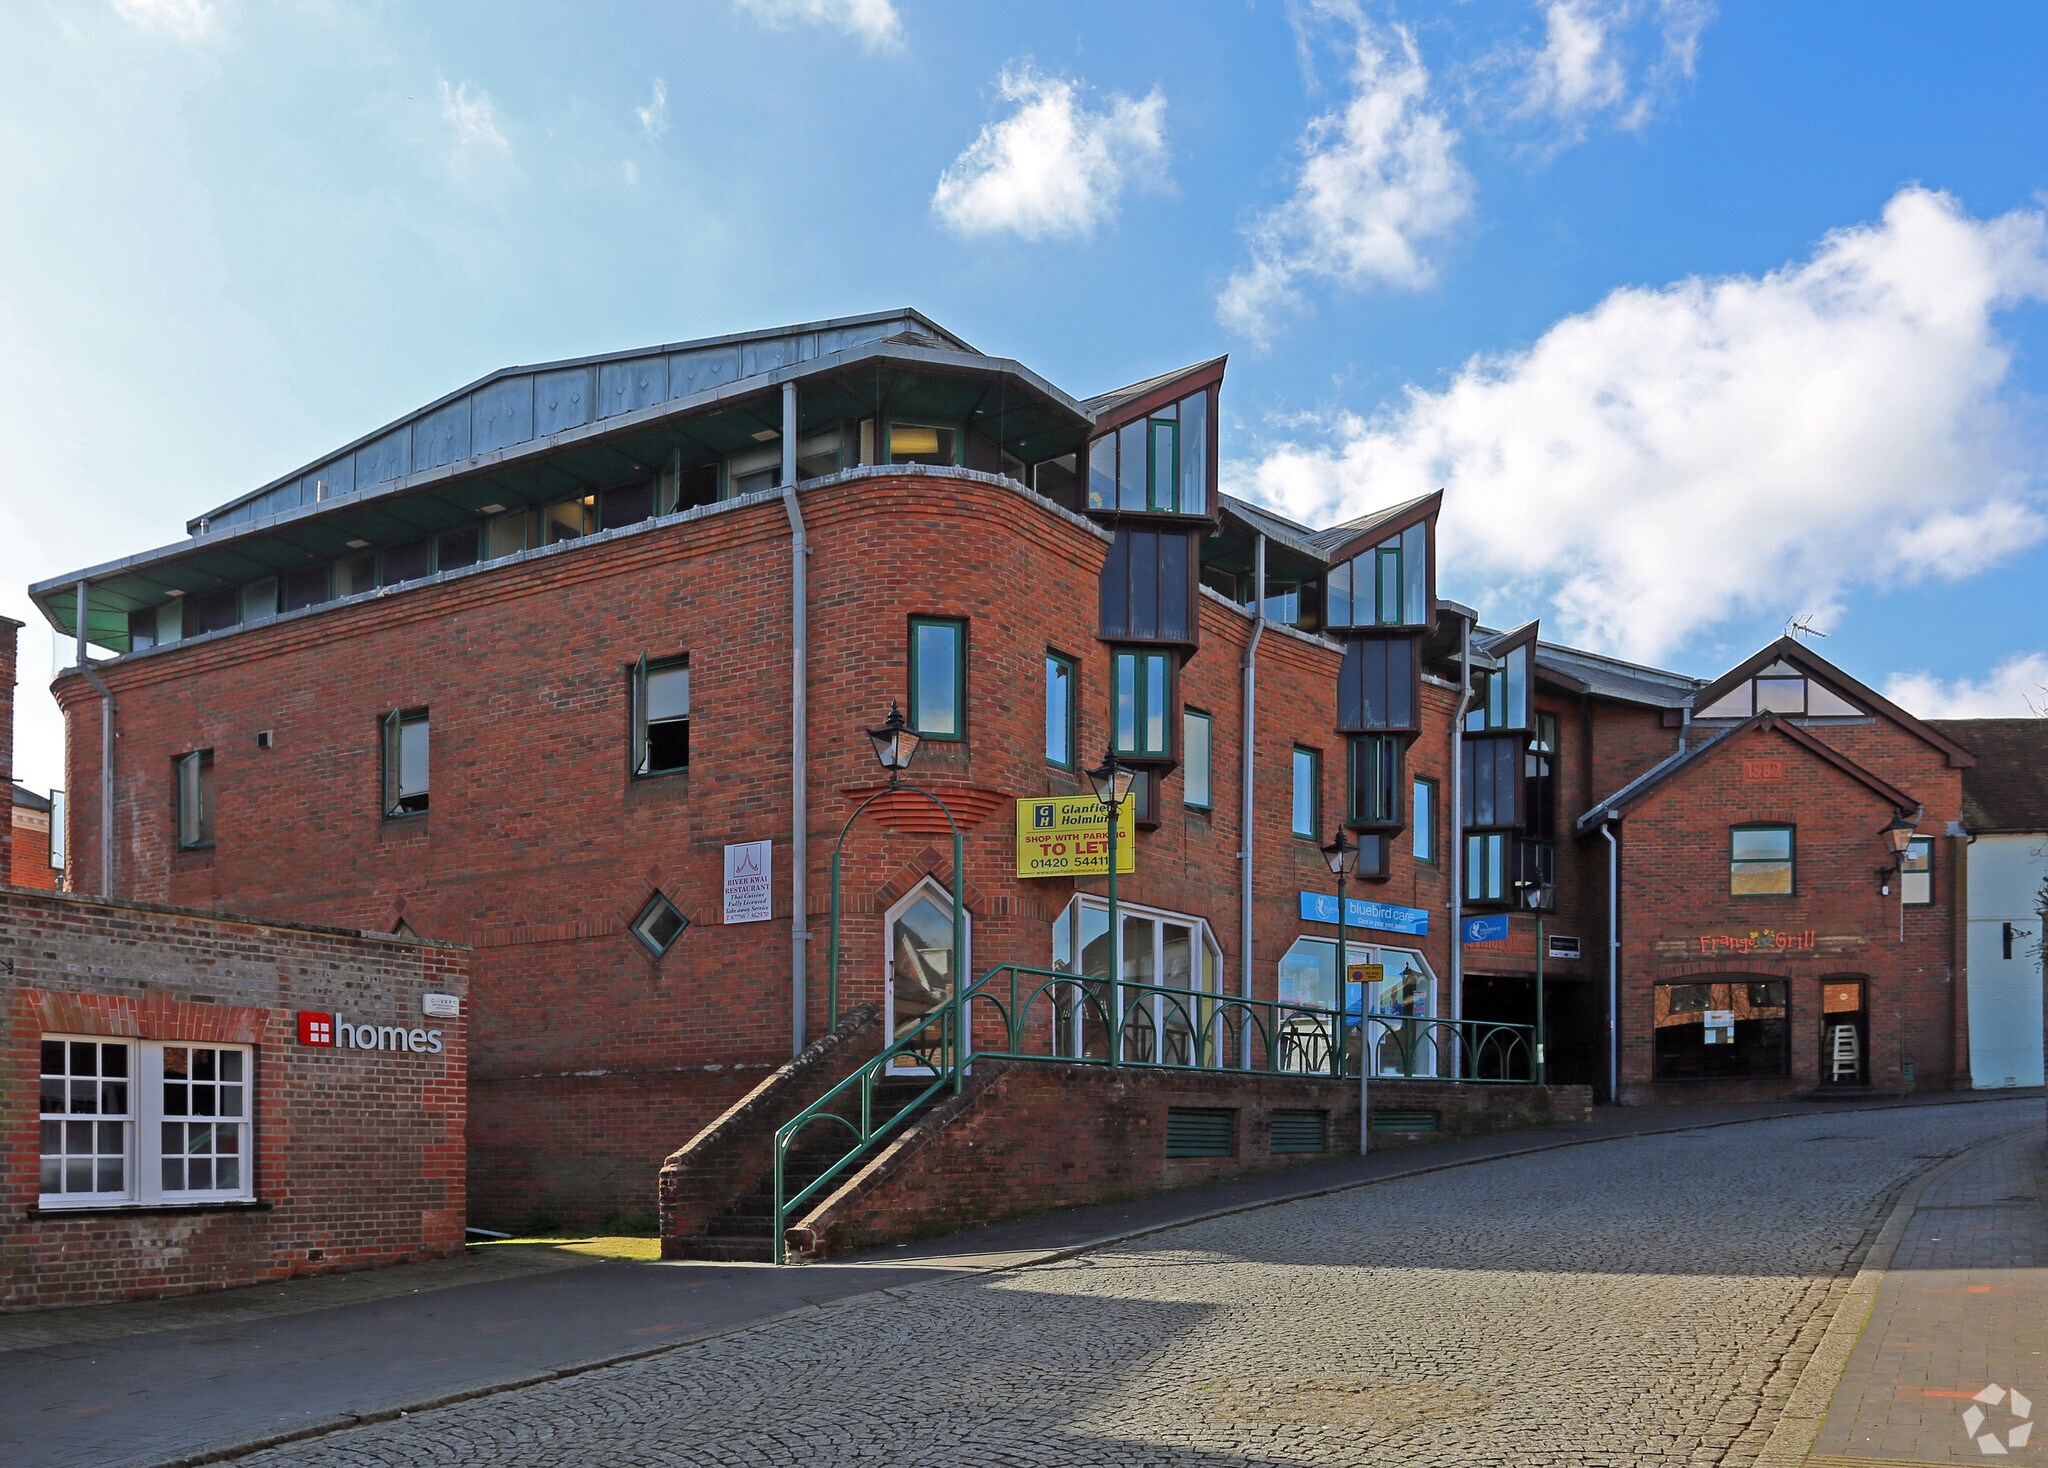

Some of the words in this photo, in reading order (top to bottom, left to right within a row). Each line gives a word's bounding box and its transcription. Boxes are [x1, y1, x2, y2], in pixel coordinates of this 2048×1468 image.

[1039, 806, 1049, 816] G
[1040, 817, 1049, 827] H
[1025, 835, 1051, 843] SHOP
[1055, 833, 1079, 841] WITH
[1083, 831, 1126, 840] PARKG
[1040, 843, 1066, 856] TO
[1075, 841, 1109, 855] LET
[1031, 857, 1069, 869] 01420
[1074, 856, 1109, 867] 54411
[728, 878, 748, 886] RIVER
[750, 876, 767, 884] KWAI
[725, 883, 770, 894] RESTAURANT
[1349, 901, 1392, 919] bluebird
[1393, 910, 1415, 922] care
[1698, 934, 1756, 954] Frango
[1774, 930, 1816, 950] Grill
[335, 1012, 442, 1054] homes
